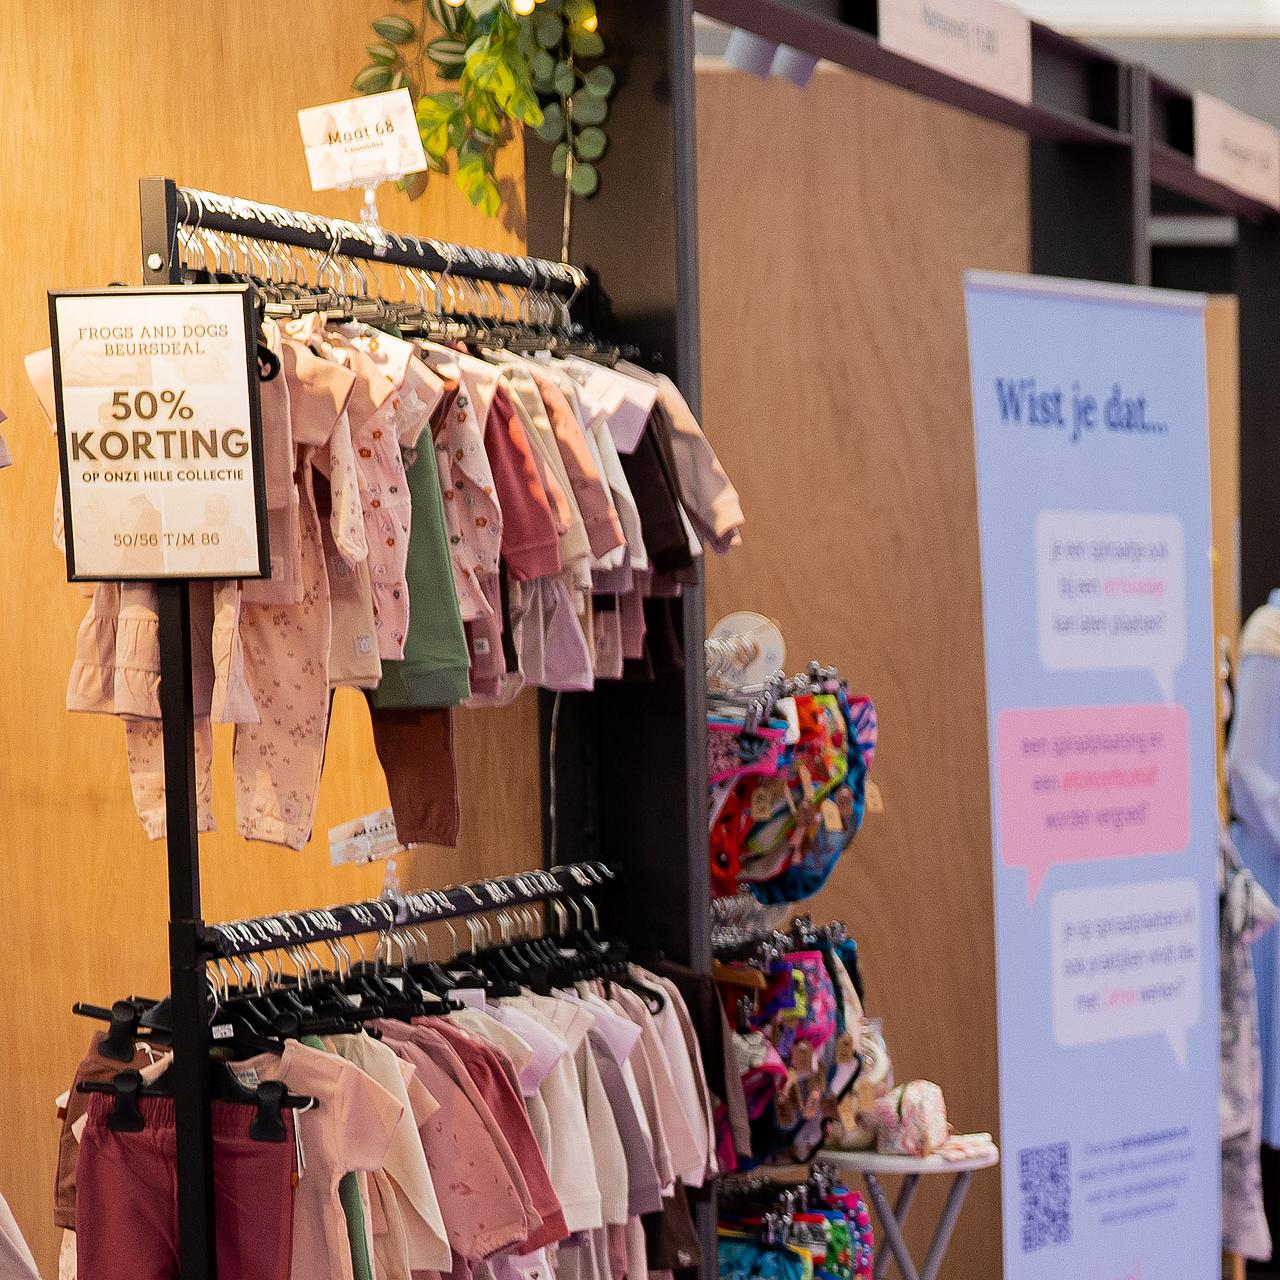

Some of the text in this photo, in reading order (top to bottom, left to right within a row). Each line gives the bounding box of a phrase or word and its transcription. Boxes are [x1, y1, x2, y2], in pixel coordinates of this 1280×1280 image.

[328, 120, 395, 145] Maat 68
[78, 324, 229, 341] FROGS AND DOGS
[105, 342, 205, 357] BEURSDEAL
[111, 390, 194, 421] 50%
[995, 376, 1168, 445] Wist je dat...
[71, 428, 249, 461] KORTING
[82, 469, 244, 483] OP ONZE HELE COLLECTIE
[113, 532, 220, 548] 50/56 T/M 86
